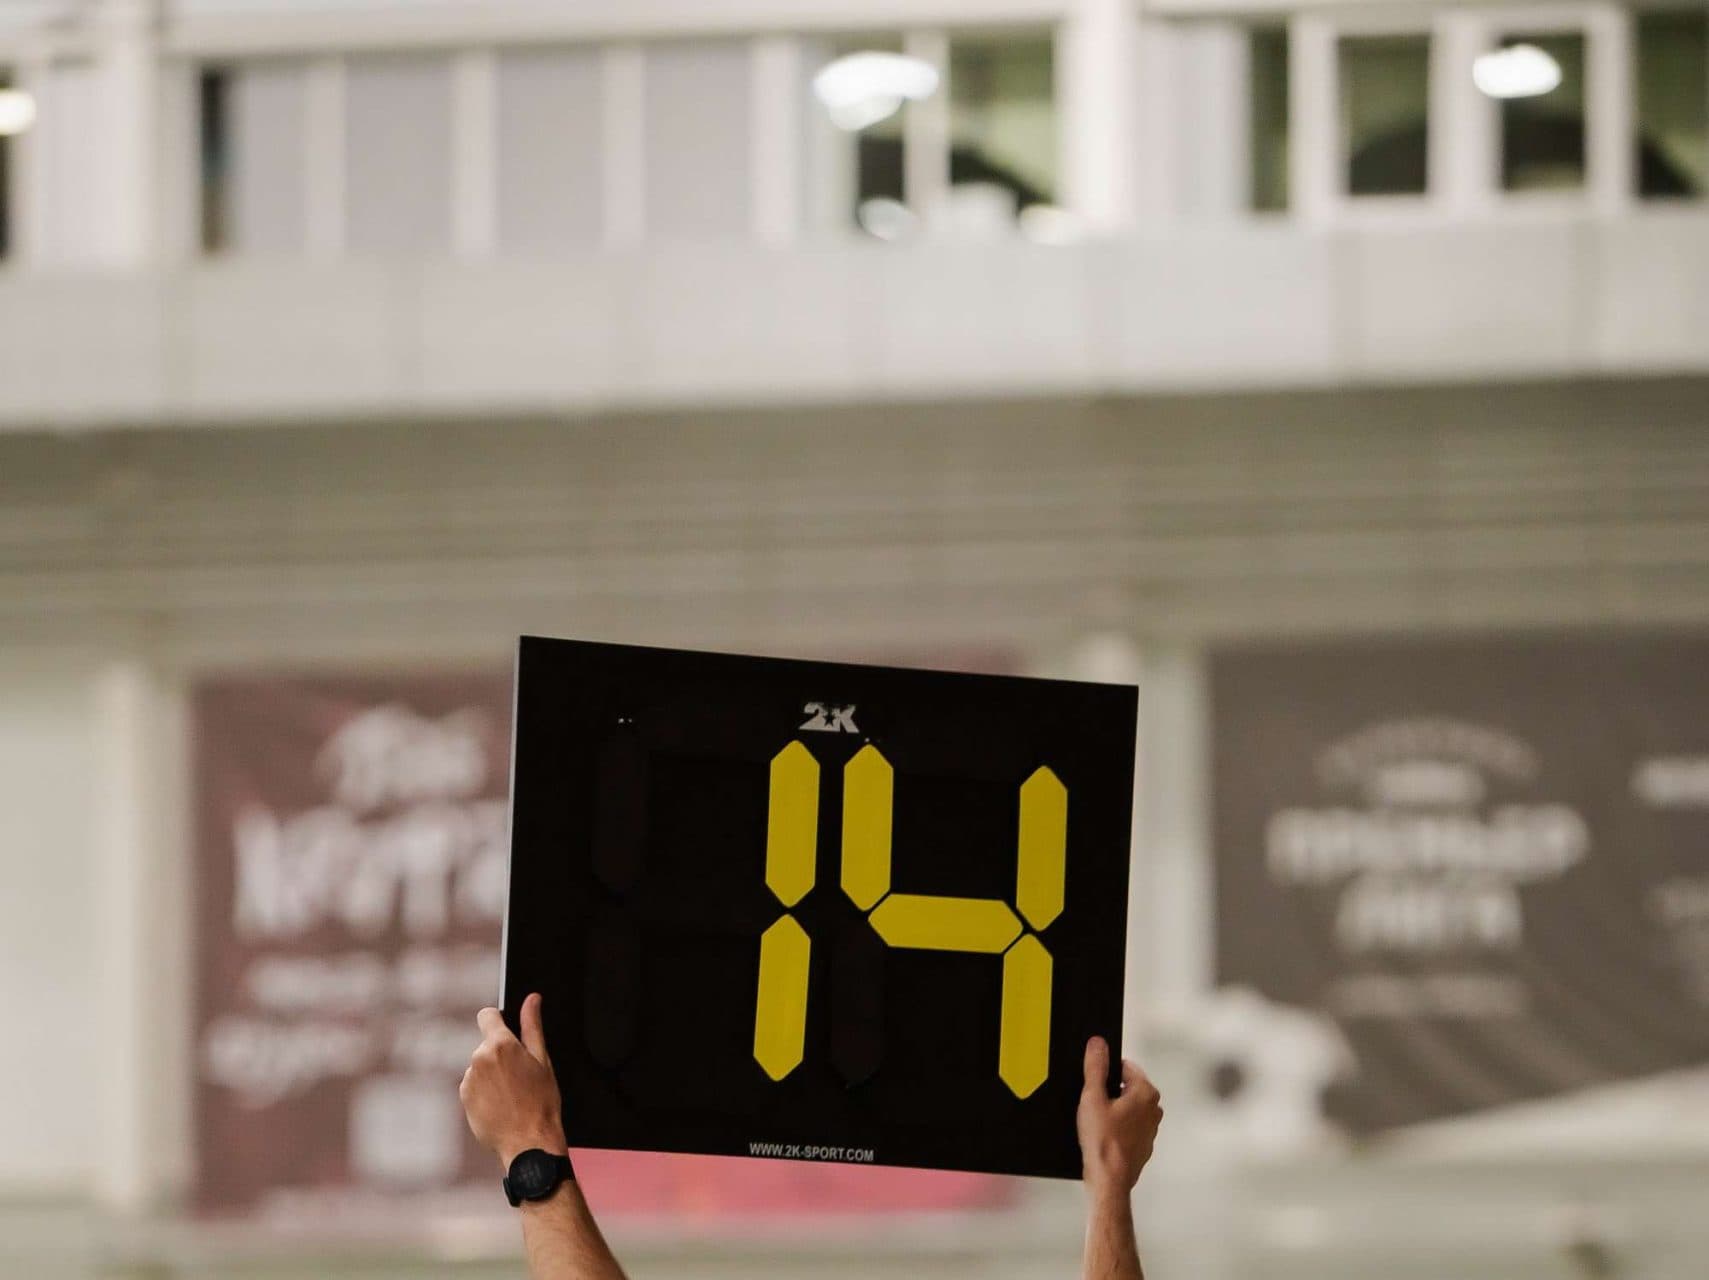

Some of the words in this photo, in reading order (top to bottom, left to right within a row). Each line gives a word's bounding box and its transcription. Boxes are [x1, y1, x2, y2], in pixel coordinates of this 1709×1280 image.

[799, 702, 860, 733] 2K
[753, 740, 1068, 1100] 14
[749, 1142, 875, 1162] WWW.2K-SPORT.COM
